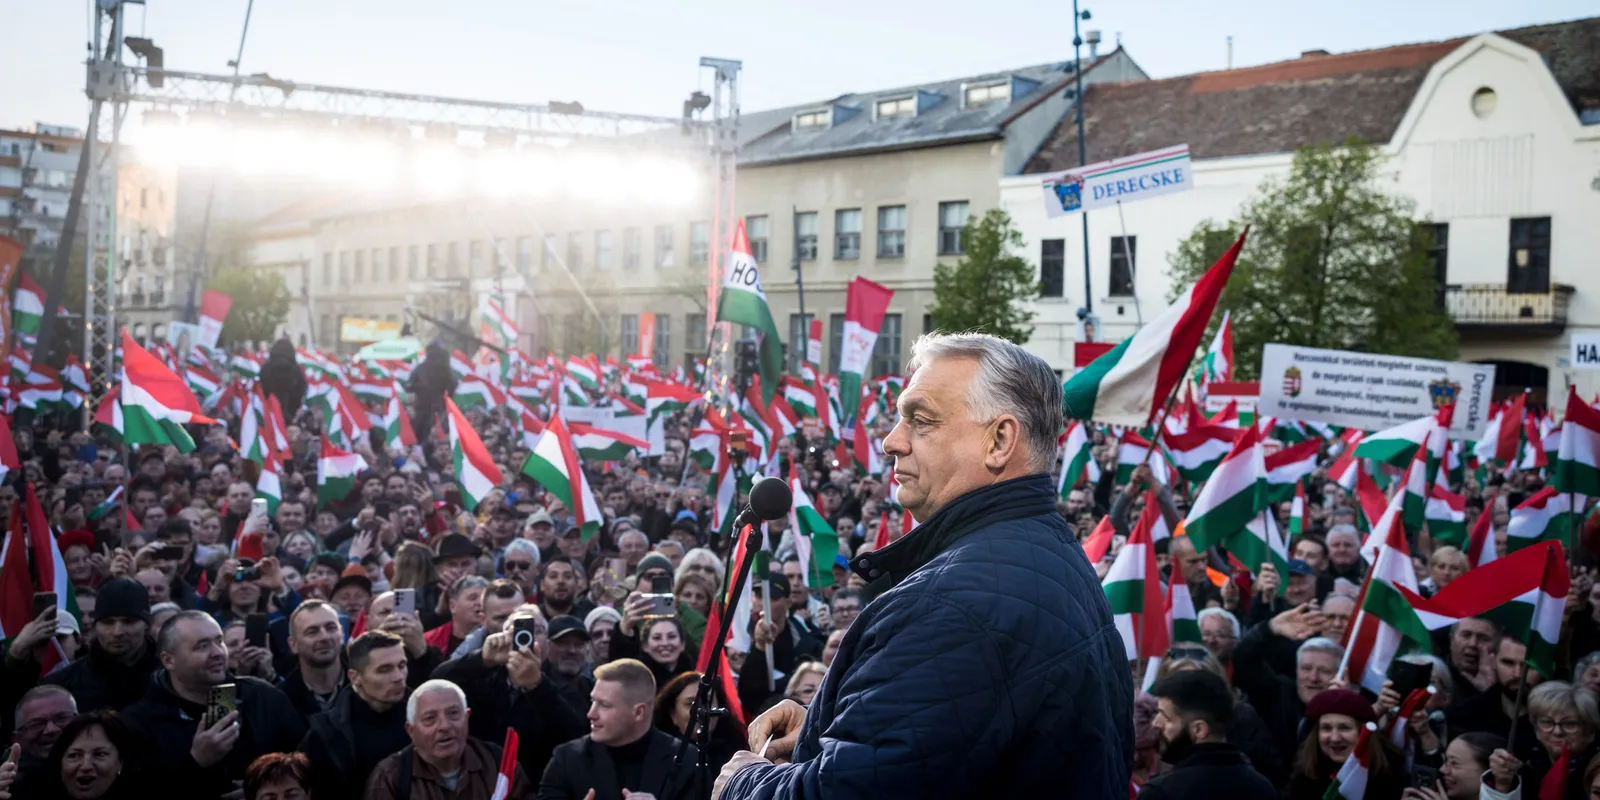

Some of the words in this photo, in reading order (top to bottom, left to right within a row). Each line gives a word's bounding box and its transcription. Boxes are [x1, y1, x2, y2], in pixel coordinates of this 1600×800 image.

[1093, 168, 1185, 200] DERECSKE
[1577, 343, 1600, 363] HA
[1465, 372, 1486, 431] Derecske
